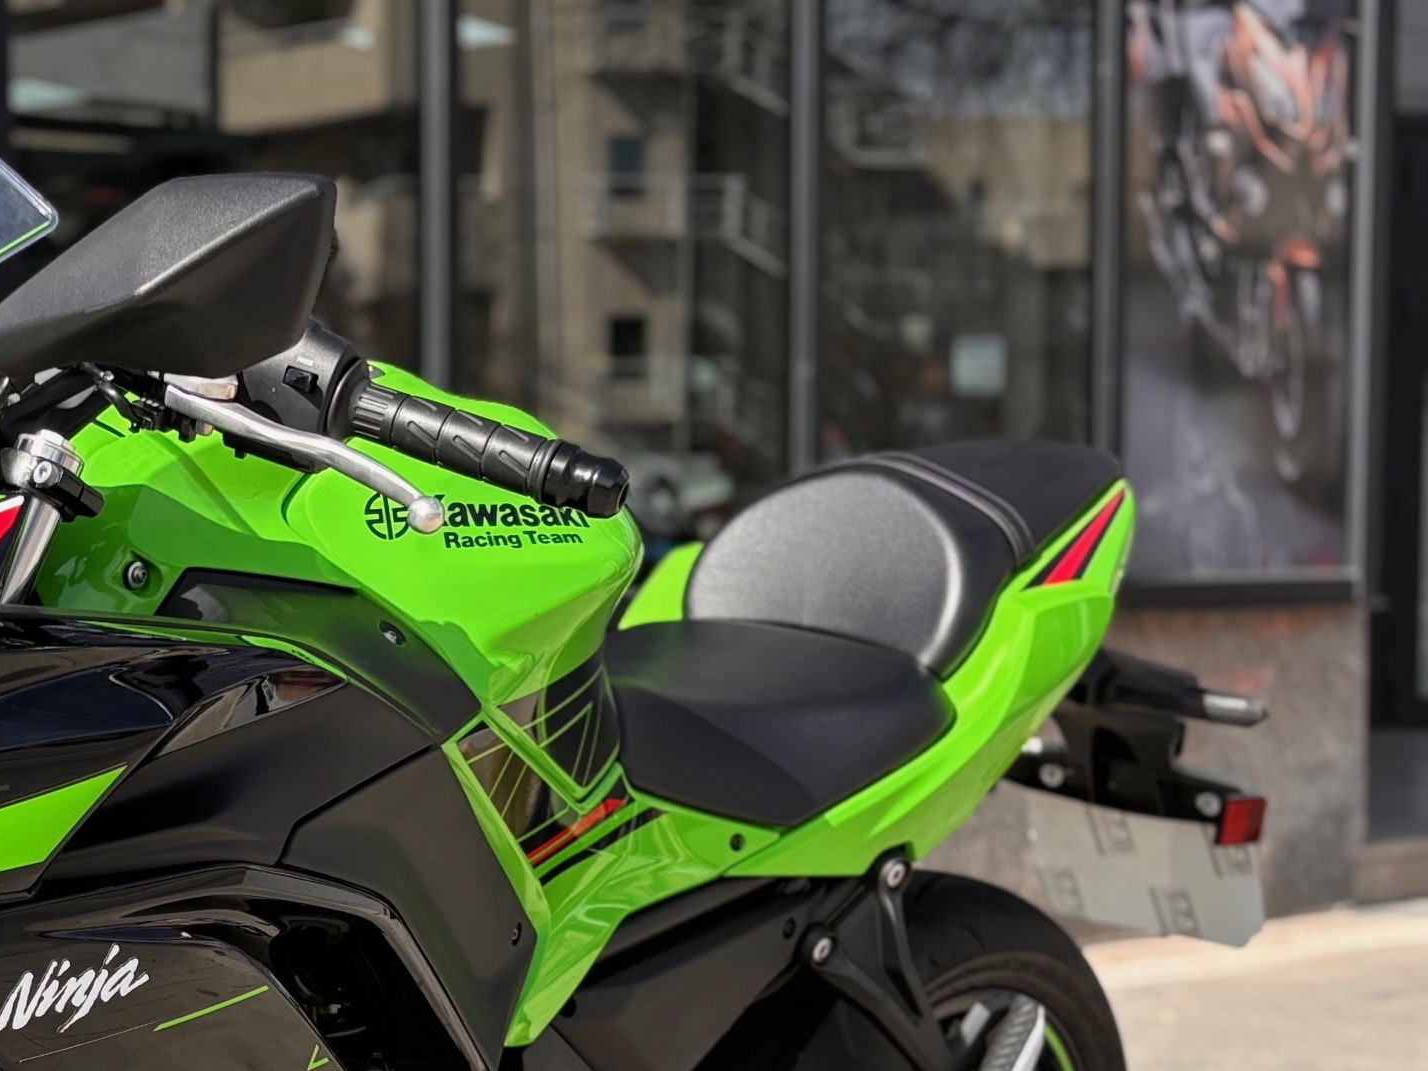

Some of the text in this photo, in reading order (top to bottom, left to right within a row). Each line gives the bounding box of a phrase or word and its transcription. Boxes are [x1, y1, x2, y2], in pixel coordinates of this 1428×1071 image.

[434, 494, 591, 528] awasaki
[444, 529, 584, 549] Racing Team
